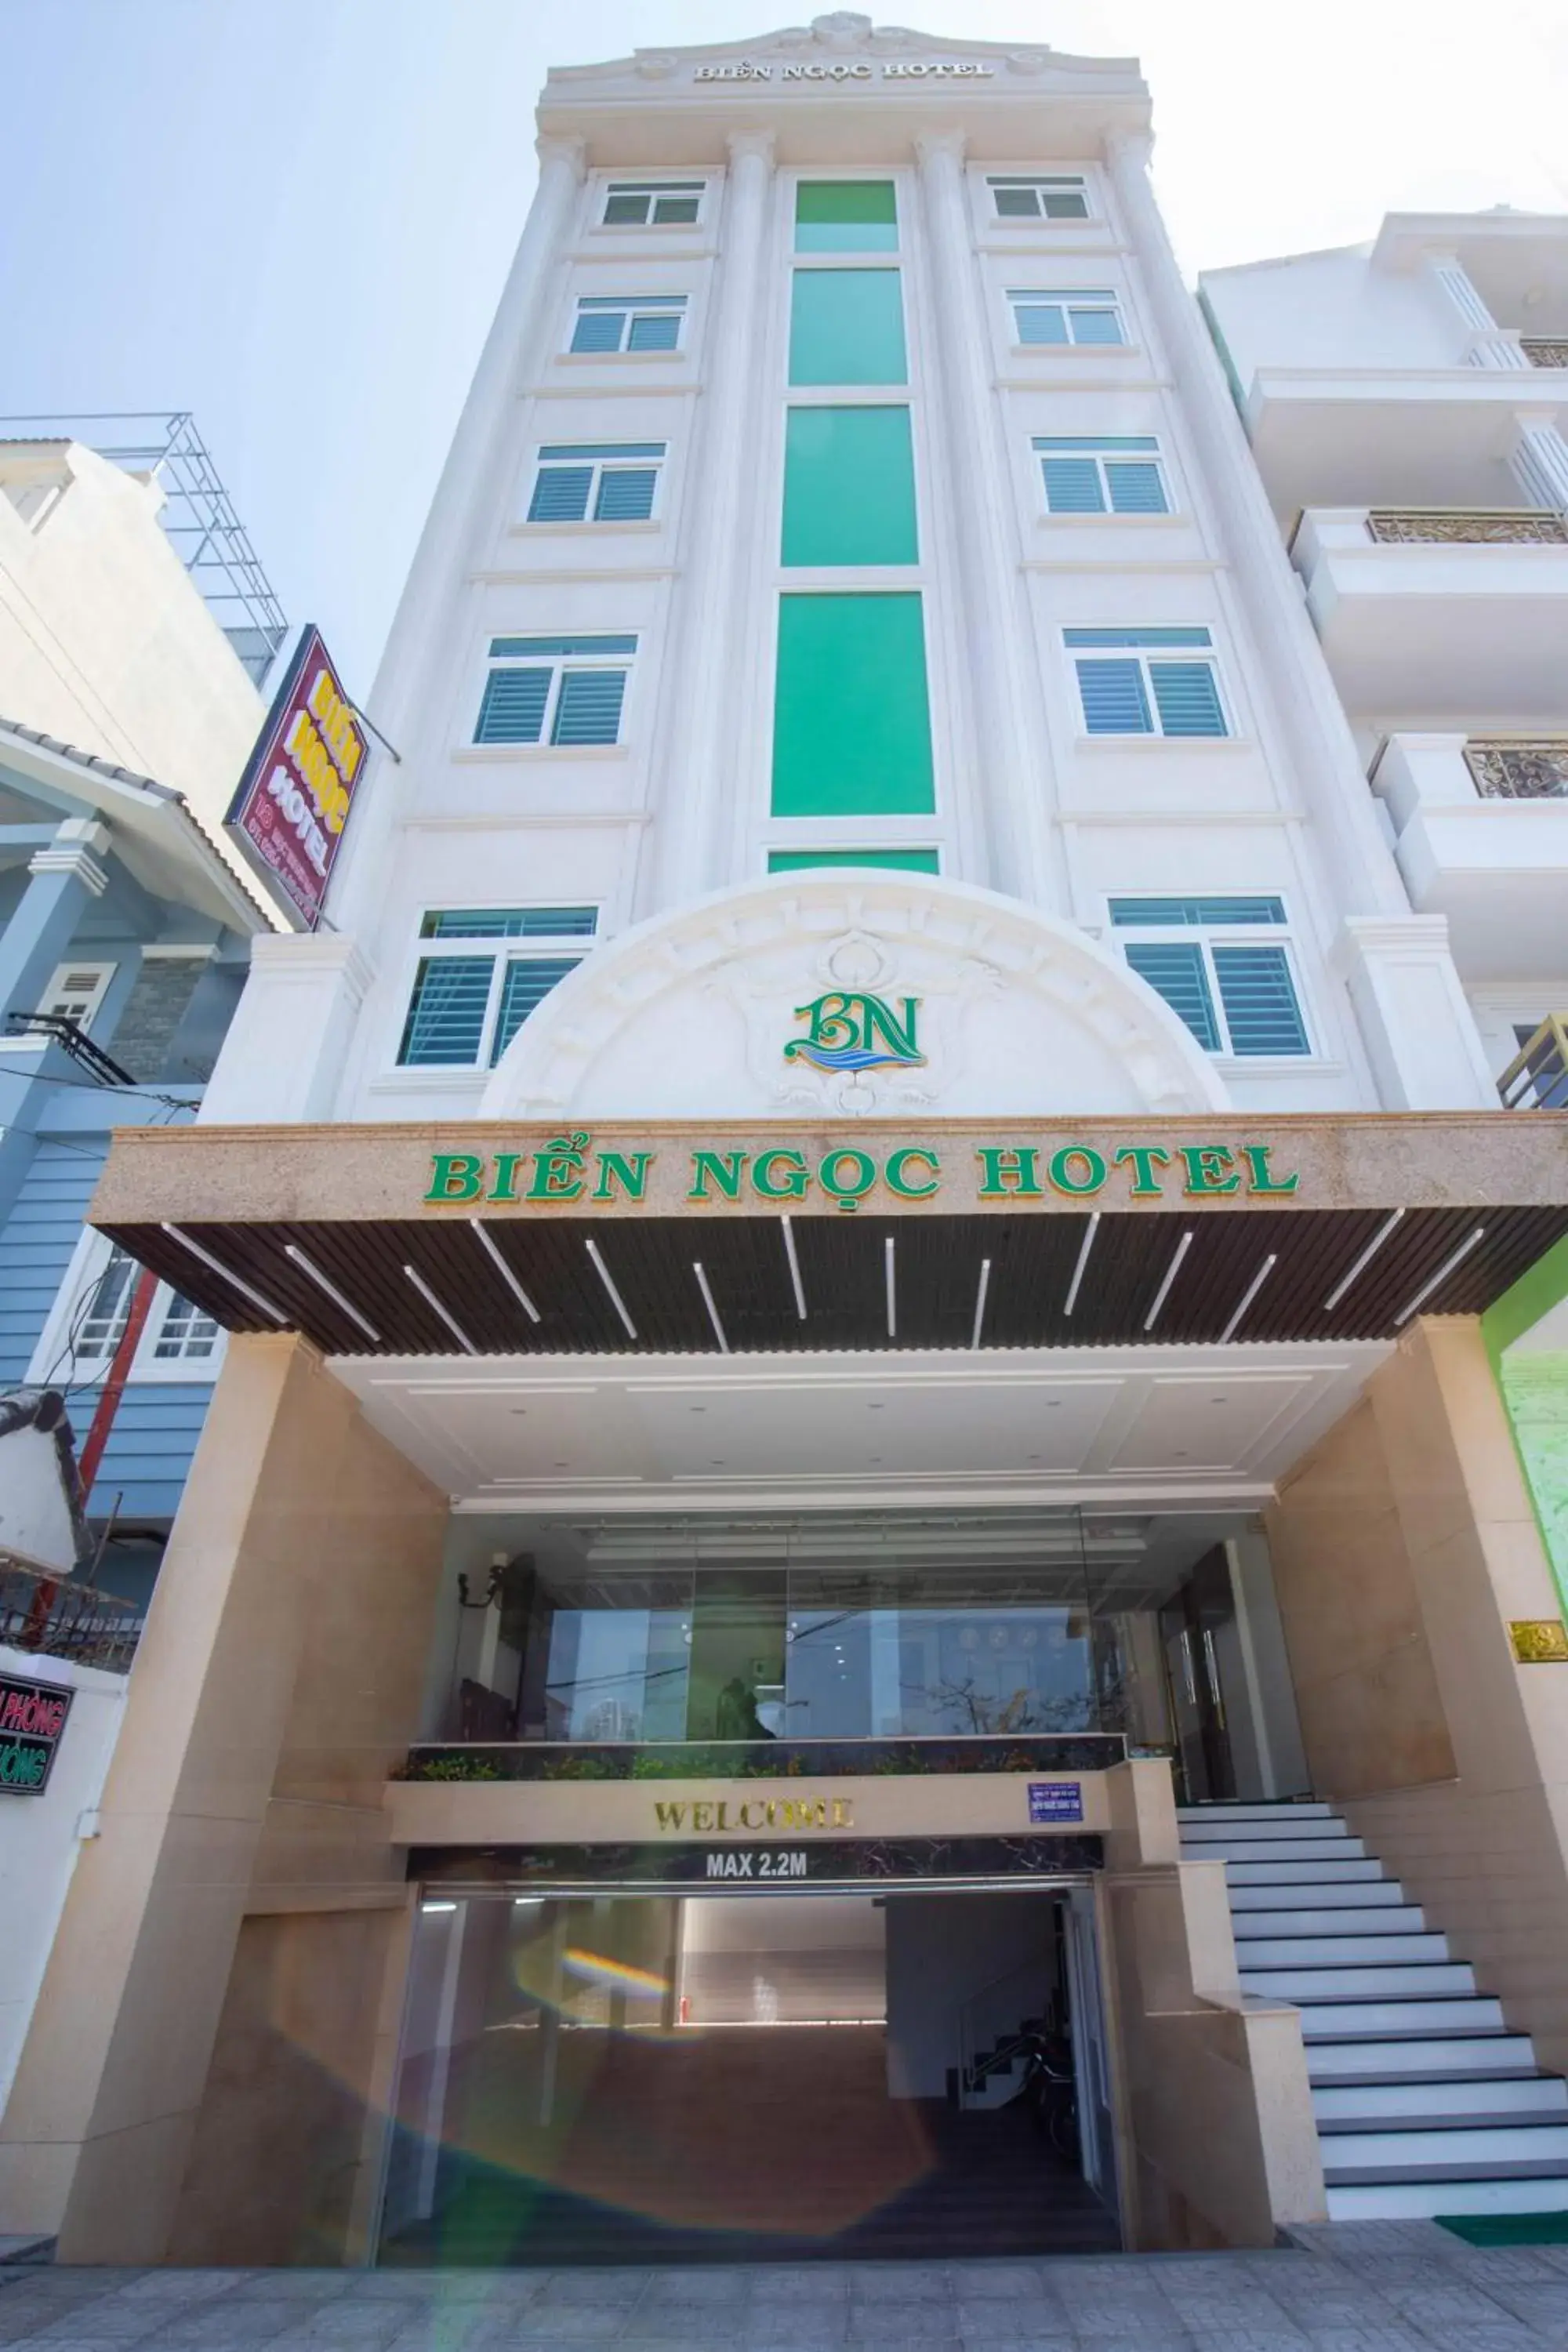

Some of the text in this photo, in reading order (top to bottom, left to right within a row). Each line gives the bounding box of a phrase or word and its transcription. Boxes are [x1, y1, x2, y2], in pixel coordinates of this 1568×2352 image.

[782, 63, 872, 82] NGỌC
[883, 62, 995, 79] HOTEL
[267, 764, 327, 877] HOTEL
[784, 992, 926, 1062] BN
[423, 1131, 1300, 1210] BIỂN NGỌC HOTEL
[654, 1797, 855, 1831] WELCOME
[707, 1852, 807, 1877] MAX 2.2M
